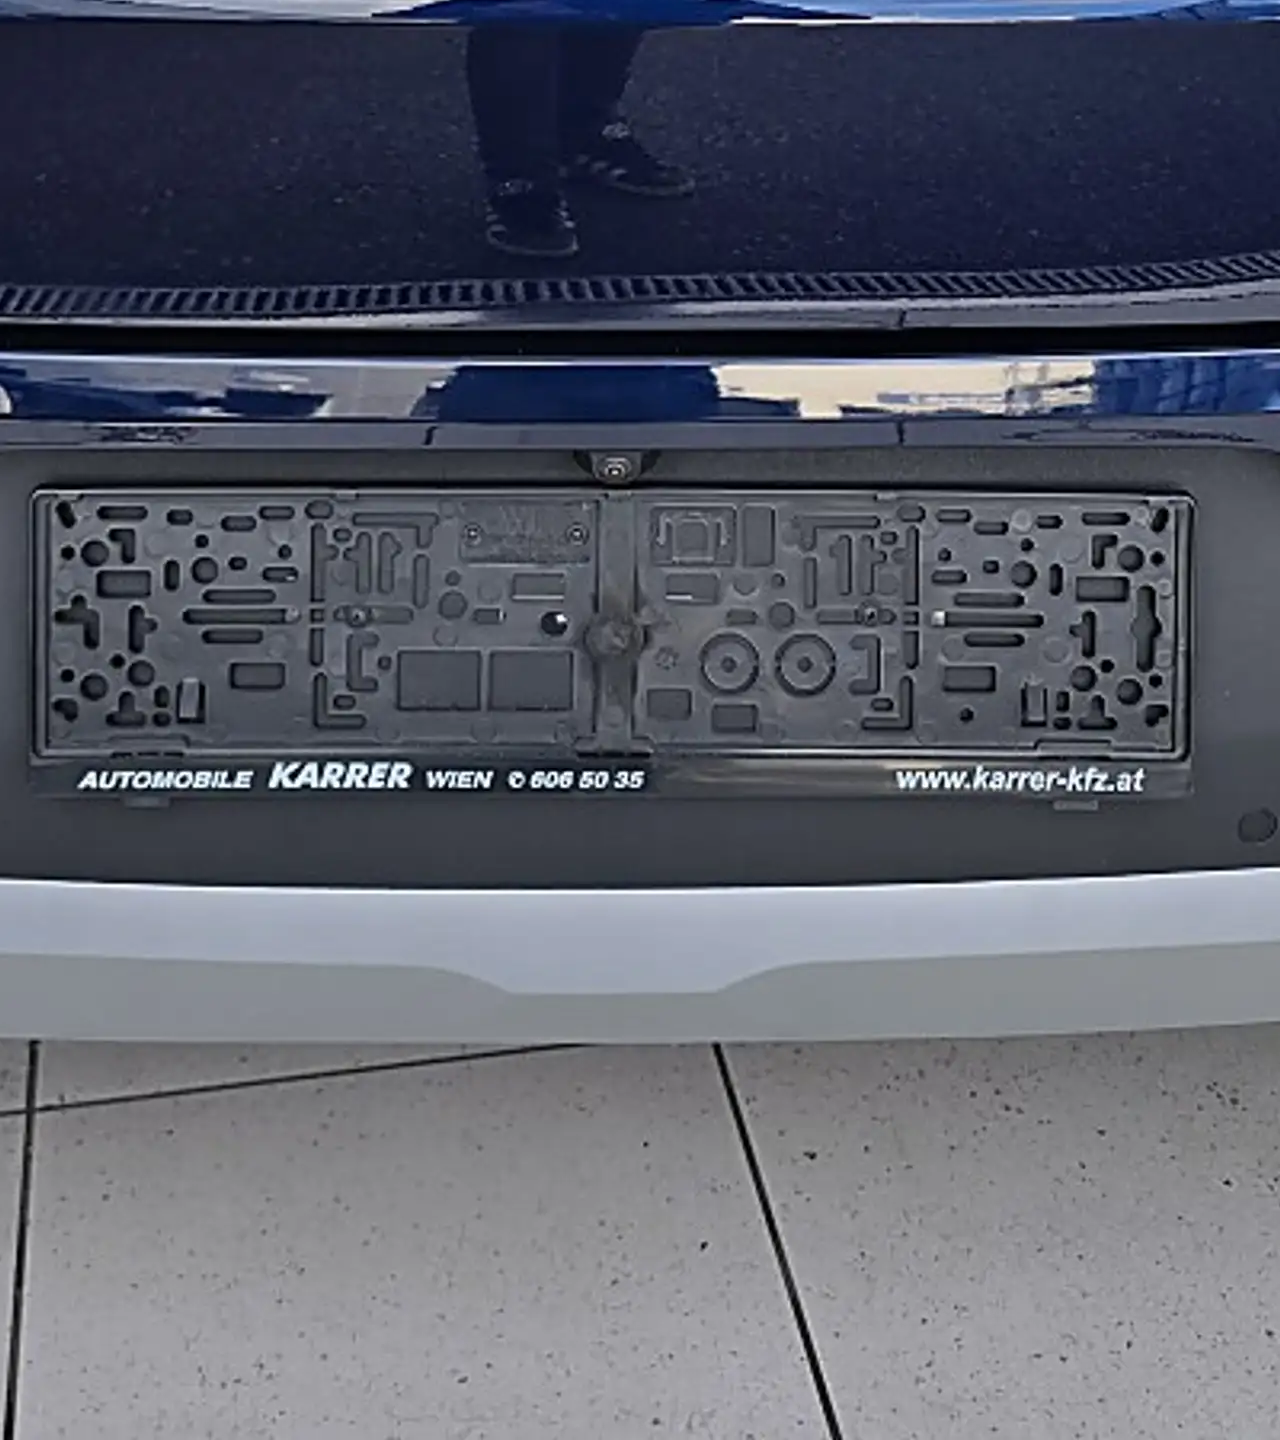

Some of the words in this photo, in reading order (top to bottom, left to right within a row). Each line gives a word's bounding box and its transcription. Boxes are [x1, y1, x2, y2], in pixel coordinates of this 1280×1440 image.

[77, 770, 254, 789] AUTOMOBILE
[268, 761, 413, 789] KARRER
[426, 770, 494, 789] WIEN
[530, 770, 574, 788] 606
[579, 770, 609, 789] 50
[614, 770, 645, 789] 35
[895, 765, 1146, 793] www.karrer-kfz.at
